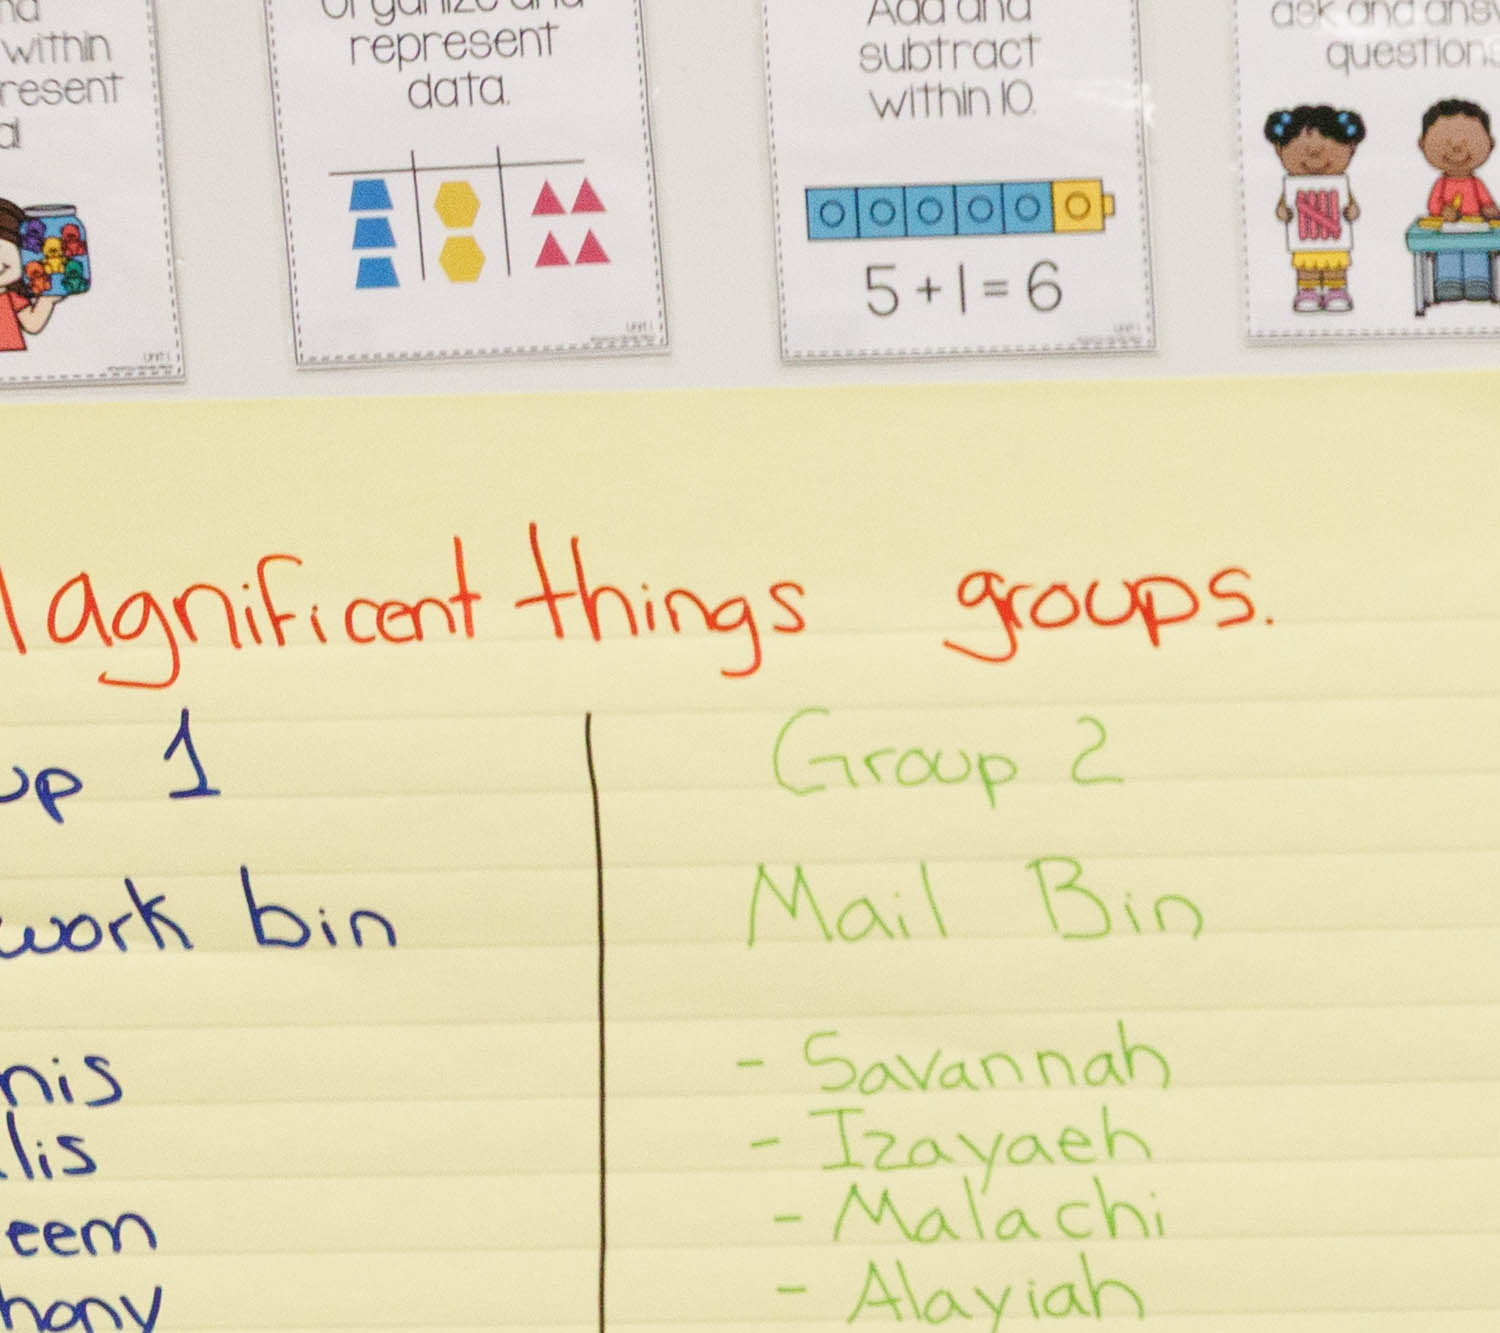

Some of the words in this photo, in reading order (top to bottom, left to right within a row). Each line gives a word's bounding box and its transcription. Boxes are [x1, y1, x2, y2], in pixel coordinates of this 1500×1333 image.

[1, 30, 111, 64] within
[350, 21, 560, 72] represent
[1271, 0, 1337, 29] ask
[1347, 0, 1413, 26] and
[859, 33, 1042, 73] subtract
[407, 71, 511, 109] data.
[869, 83, 991, 119] within
[515, 522, 804, 677] things
[163, 707, 221, 799] 1
[772, 706, 1019, 810] Group
[1071, 715, 1125, 787] 2
[241, 865, 397, 948] bin
[747, 860, 947, 949] Mail
[1026, 854, 1204, 940] Bin
[804, 1019, 1172, 1095] Savannah
[0, 1110, 97, 1180] lis
[833, 1174, 1165, 1243] Malachi
